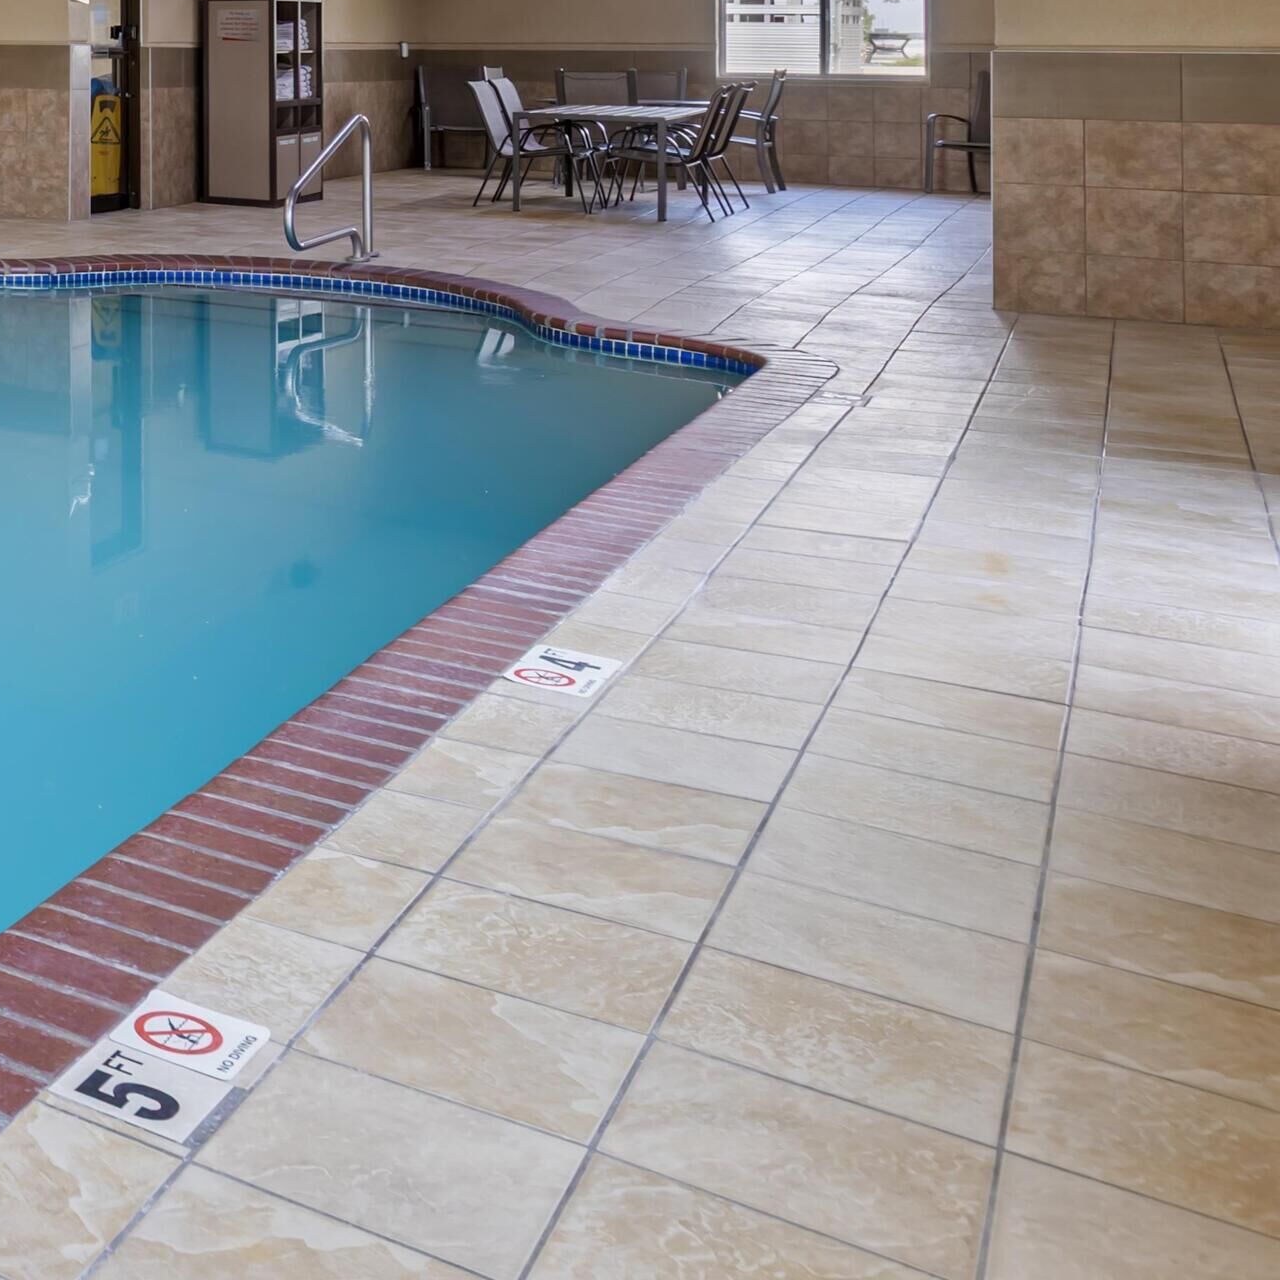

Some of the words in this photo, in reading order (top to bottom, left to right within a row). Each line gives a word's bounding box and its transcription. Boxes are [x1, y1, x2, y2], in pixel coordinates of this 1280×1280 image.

[539, 655, 602, 672] 4
[102, 1050, 144, 1076] FT
[216, 1060, 234, 1072] NO
[228, 1035, 257, 1060] DIVING
[74, 1069, 180, 1121] 5
